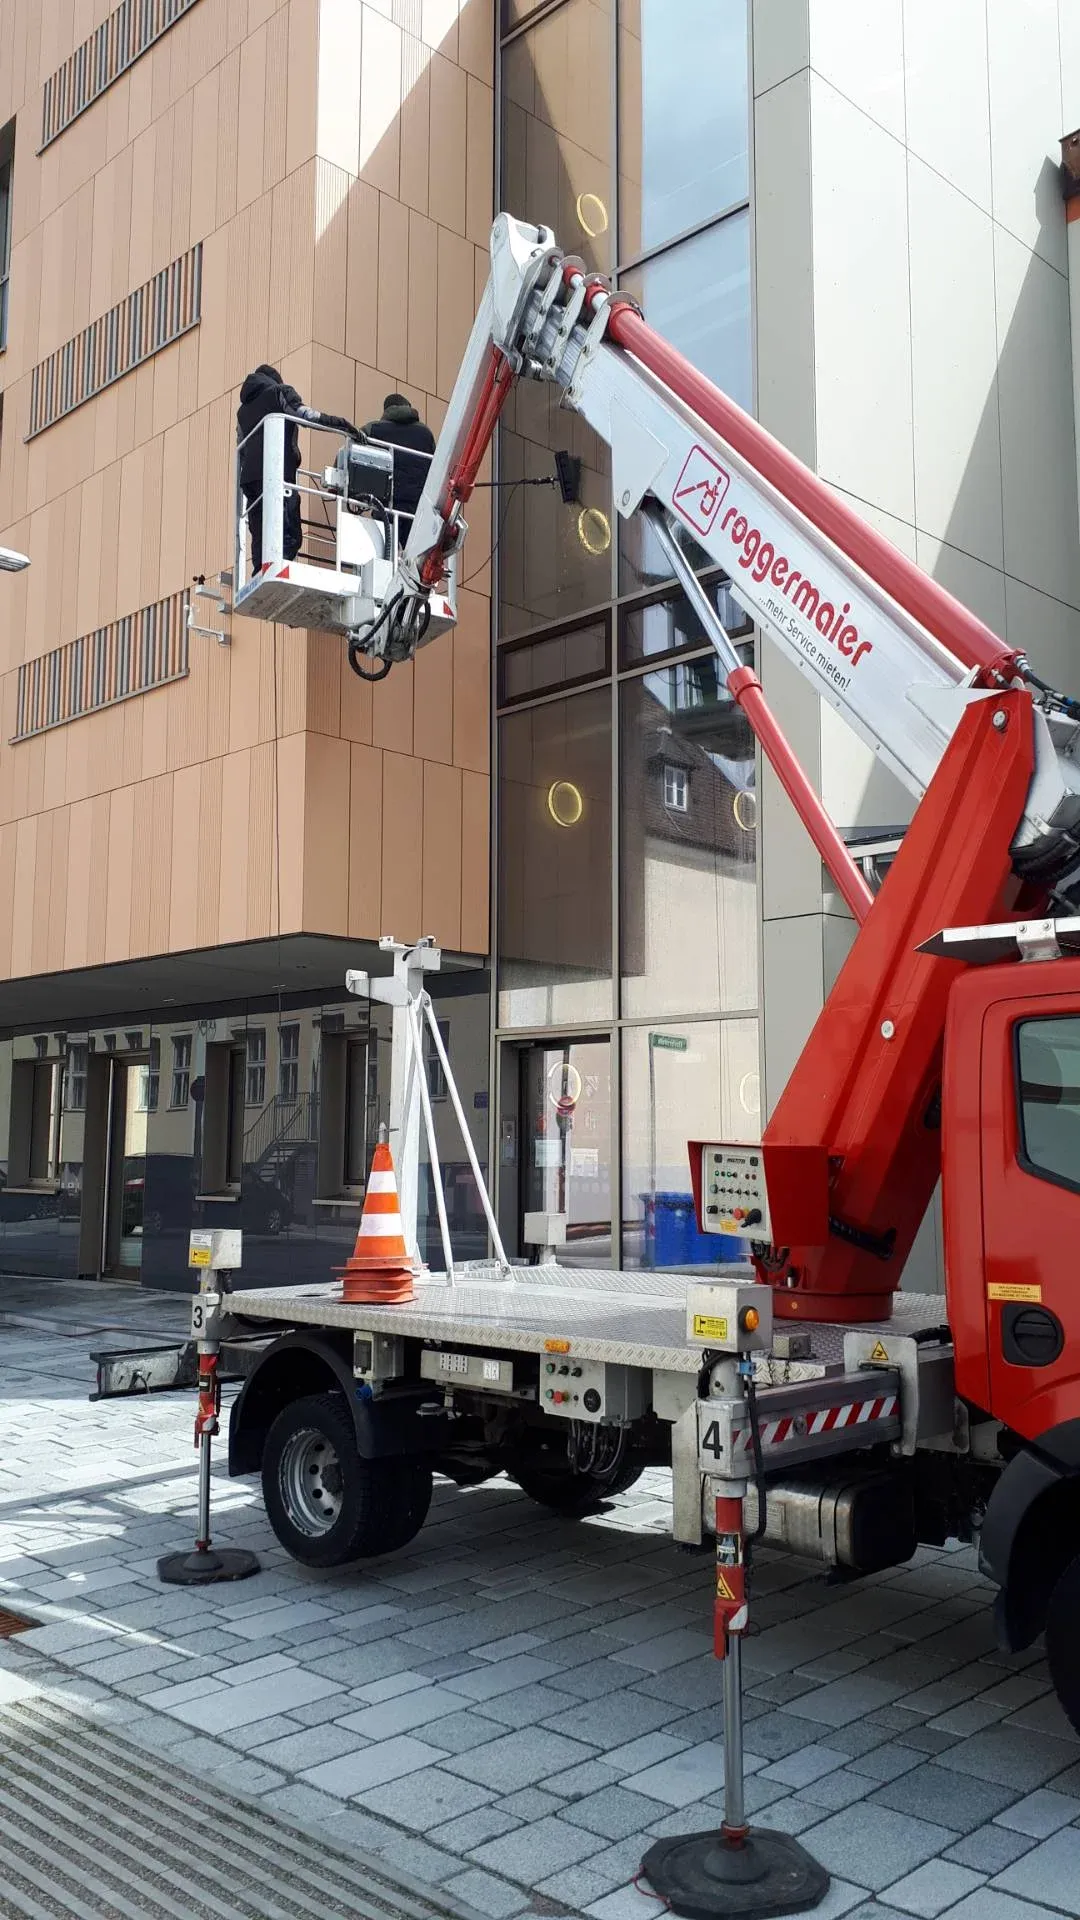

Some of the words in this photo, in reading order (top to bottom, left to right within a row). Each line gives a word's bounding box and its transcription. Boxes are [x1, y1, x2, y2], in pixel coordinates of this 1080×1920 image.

[720, 507, 873, 667] roggermaier
[758, 597, 788, 625] ...mehr
[786, 618, 817, 658] Service
[815, 651, 852, 692] mieten!
[193, 1305, 203, 1329] 3
[702, 1420, 724, 1460] 4
